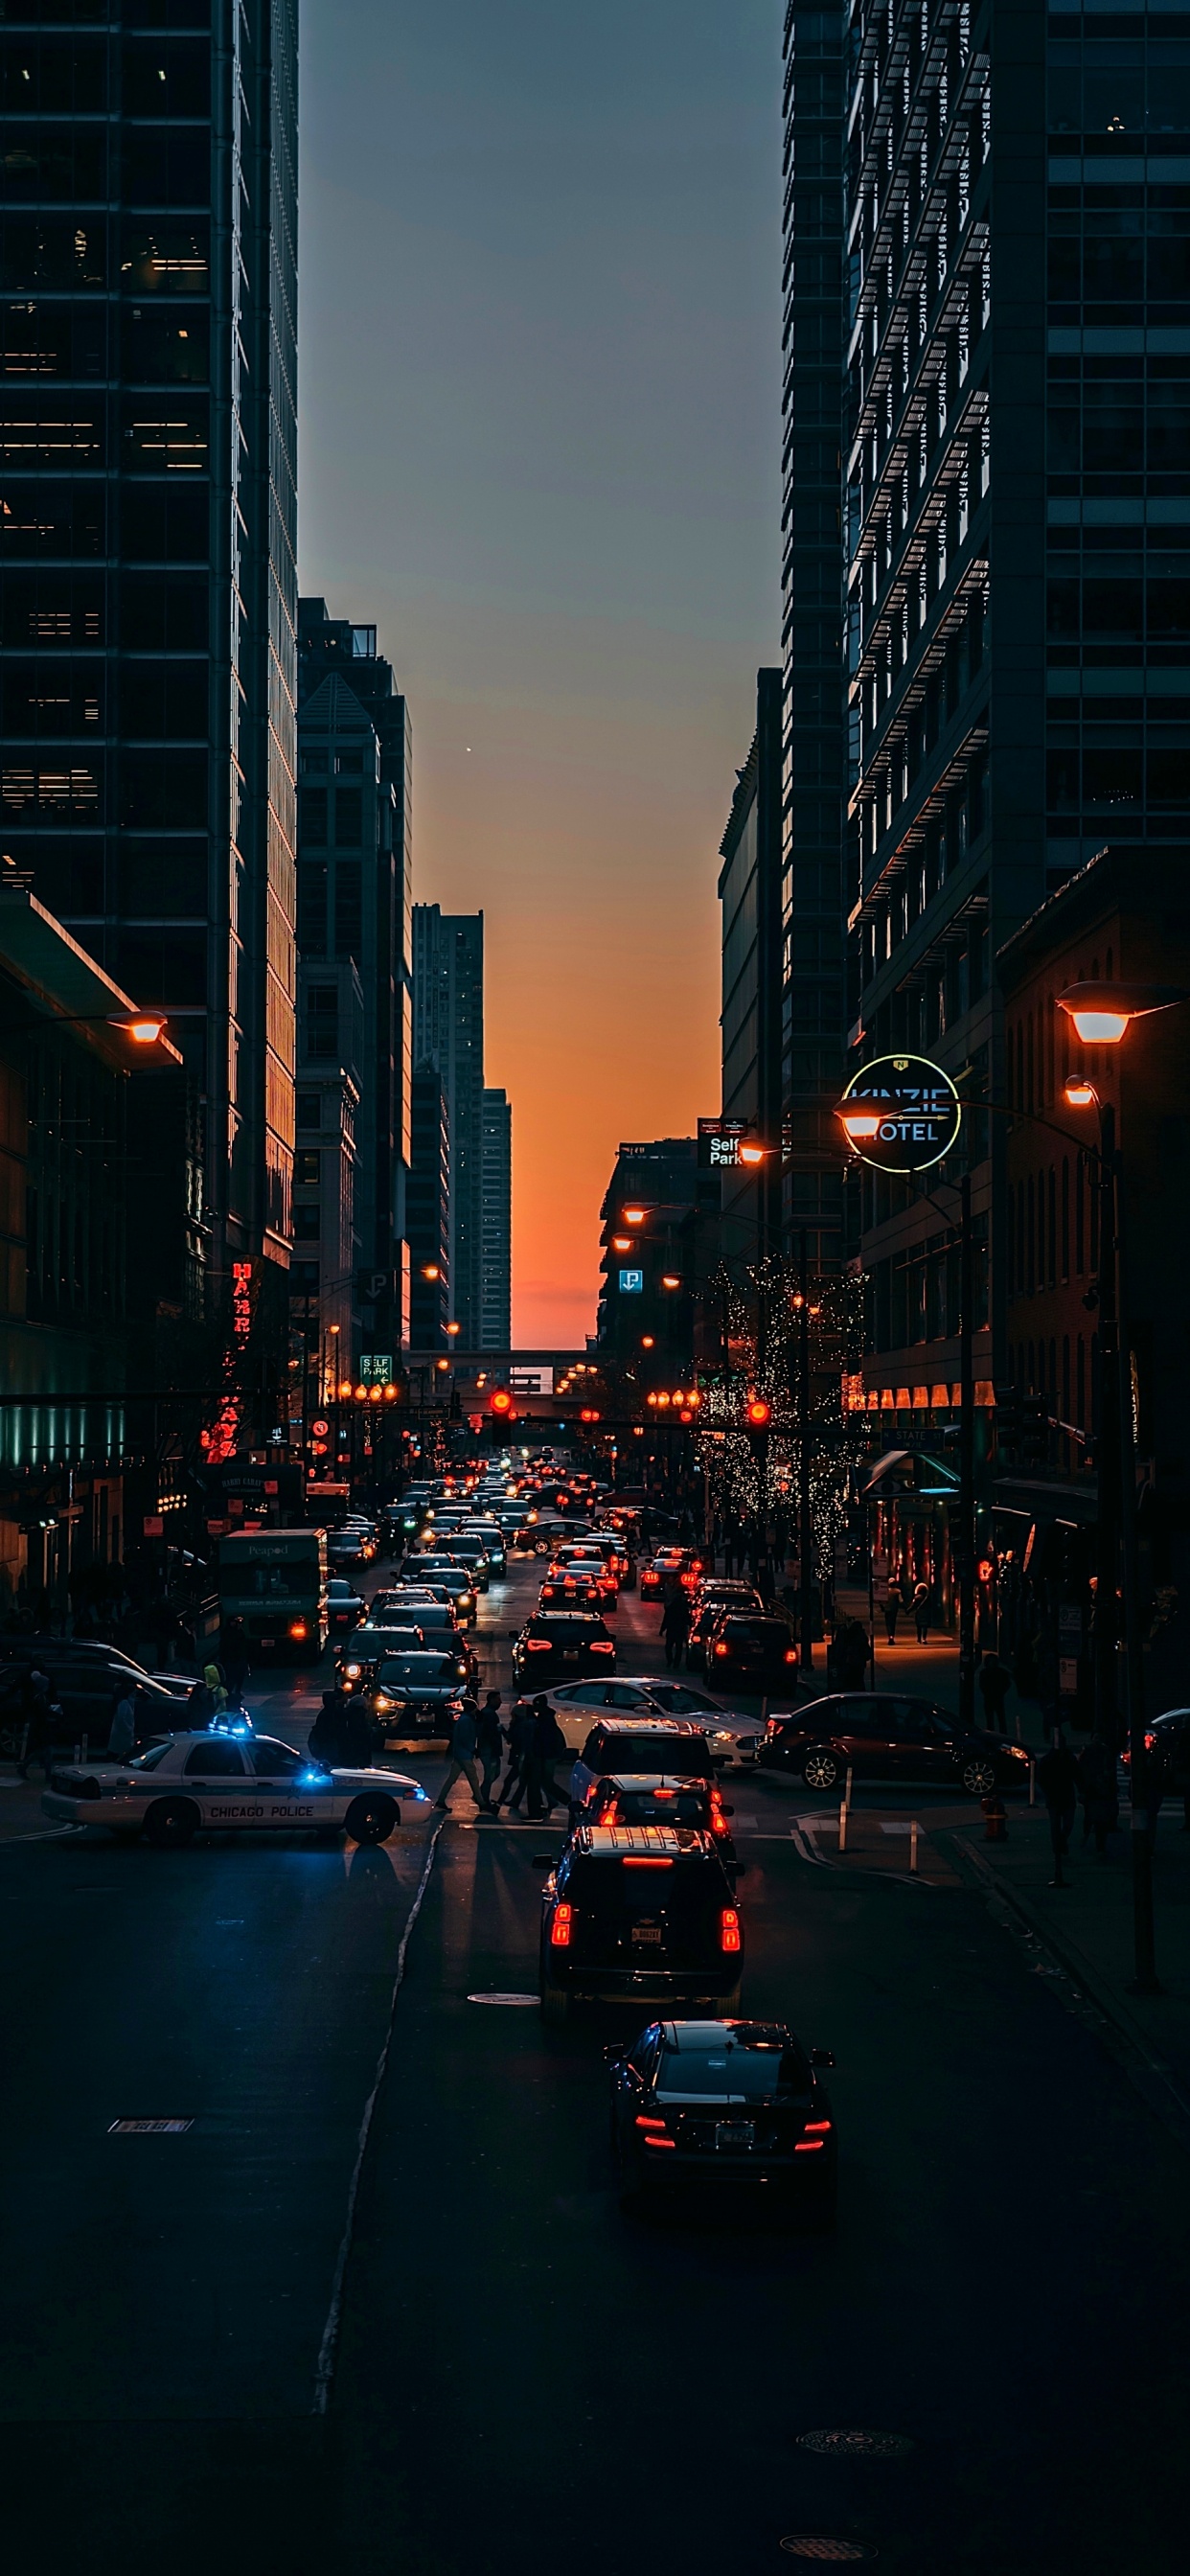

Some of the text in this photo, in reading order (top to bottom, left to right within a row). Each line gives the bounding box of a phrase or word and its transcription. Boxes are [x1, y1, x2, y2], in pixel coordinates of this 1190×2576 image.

[863, 1123, 939, 1141] OTEL
[710, 1138, 740, 1151] Self
[710, 1152, 744, 1164] Park
[363, 1358, 388, 1367] SELF
[896, 1431, 927, 1440] STATE
[249, 1545, 288, 1556] Peapod
[211, 1806, 314, 1818] CHICAGO POLICE
